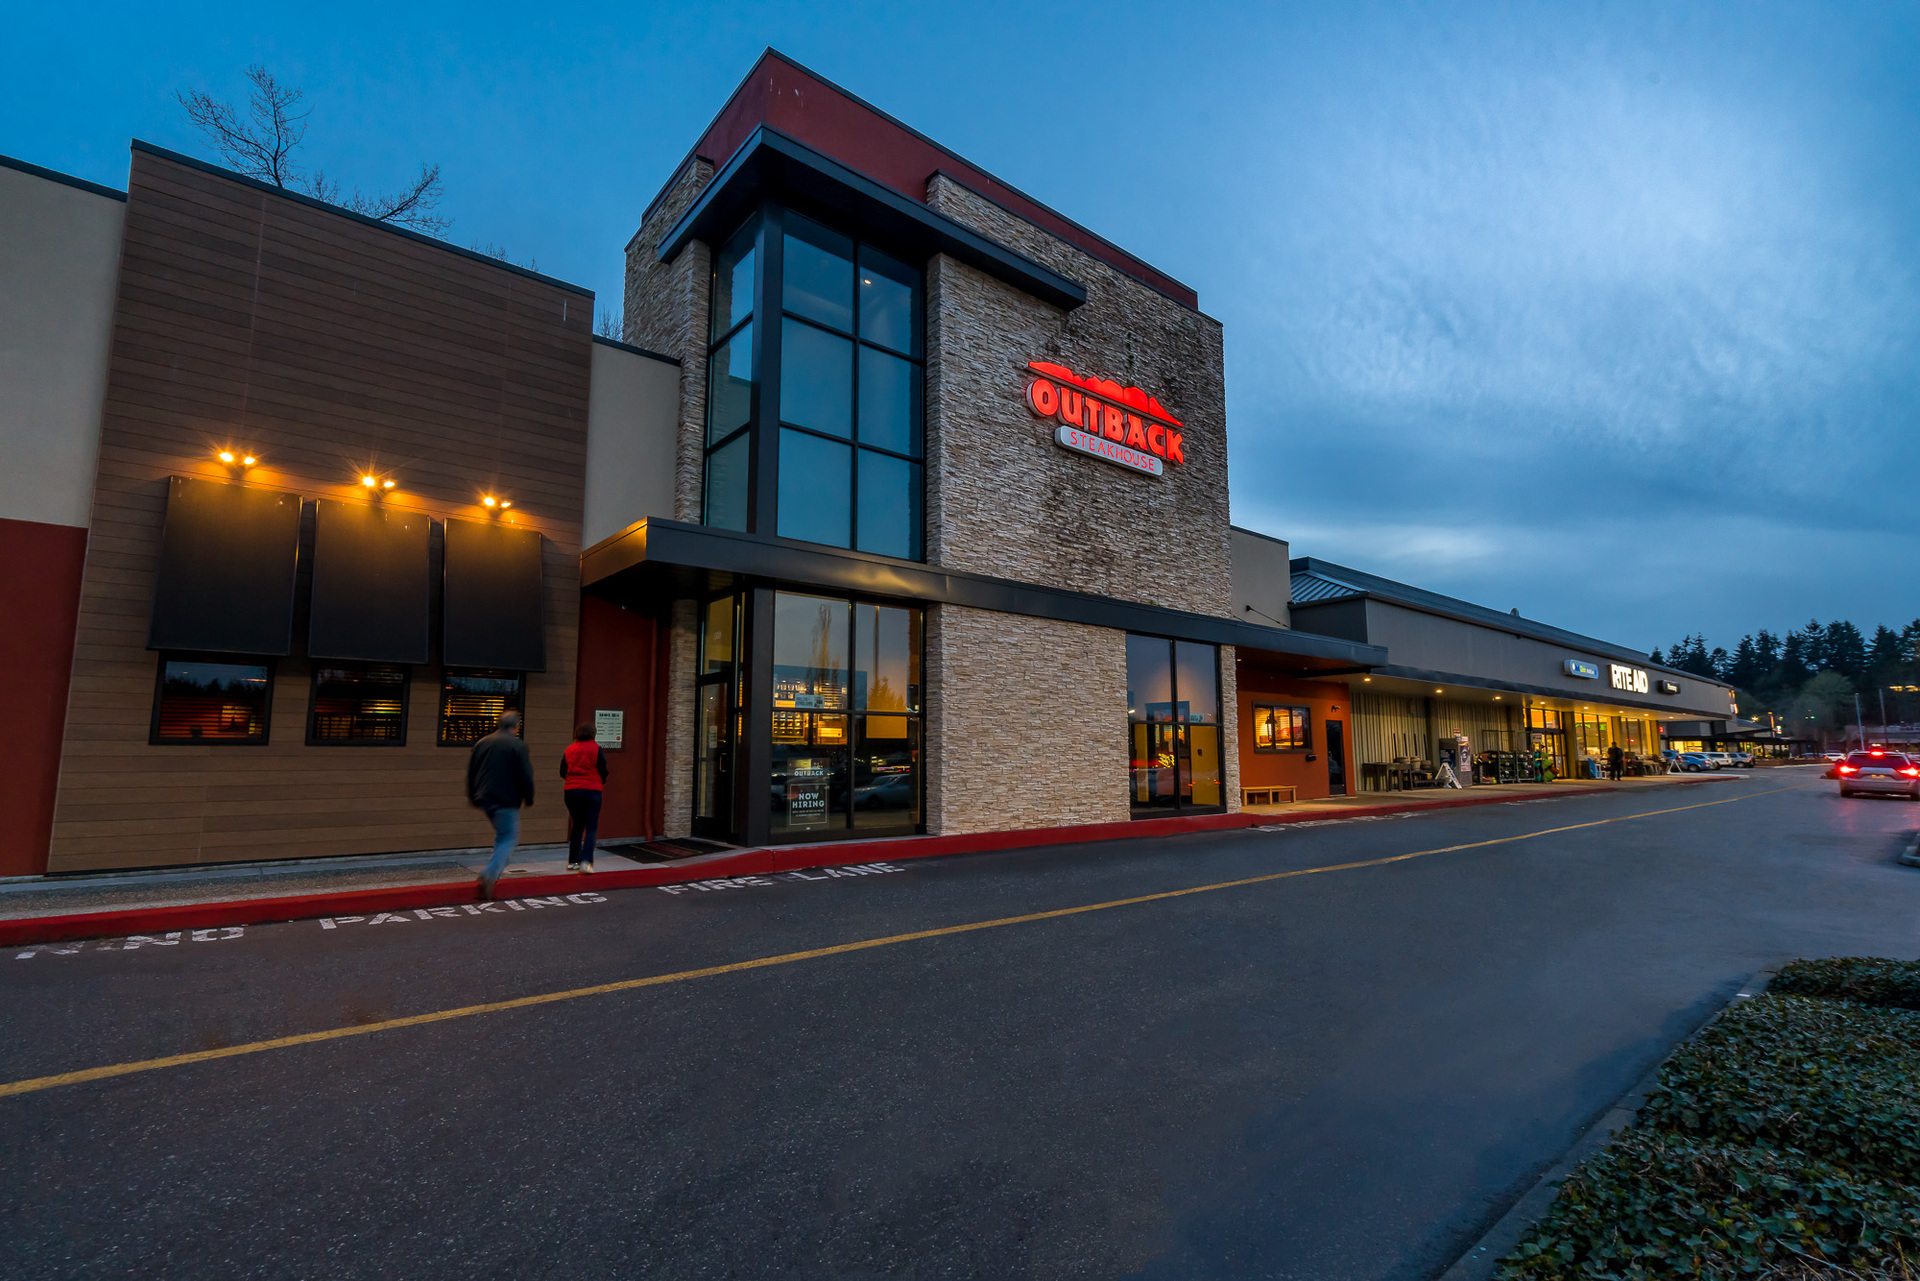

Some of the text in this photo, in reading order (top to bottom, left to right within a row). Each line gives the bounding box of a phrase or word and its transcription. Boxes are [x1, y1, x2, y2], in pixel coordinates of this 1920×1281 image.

[1029, 378, 1184, 465] OUTBACK
[1070, 431, 1155, 472] STEAKHOUSE
[1611, 664, 1633, 691] RITE
[1633, 669, 1648, 694] AID
[792, 800, 825, 808] HIRING
[798, 792, 819, 801] NOW
[319, 892, 608, 930] PARKING
[657, 876, 774, 895] FIRE
[790, 862, 906, 881] LANE
